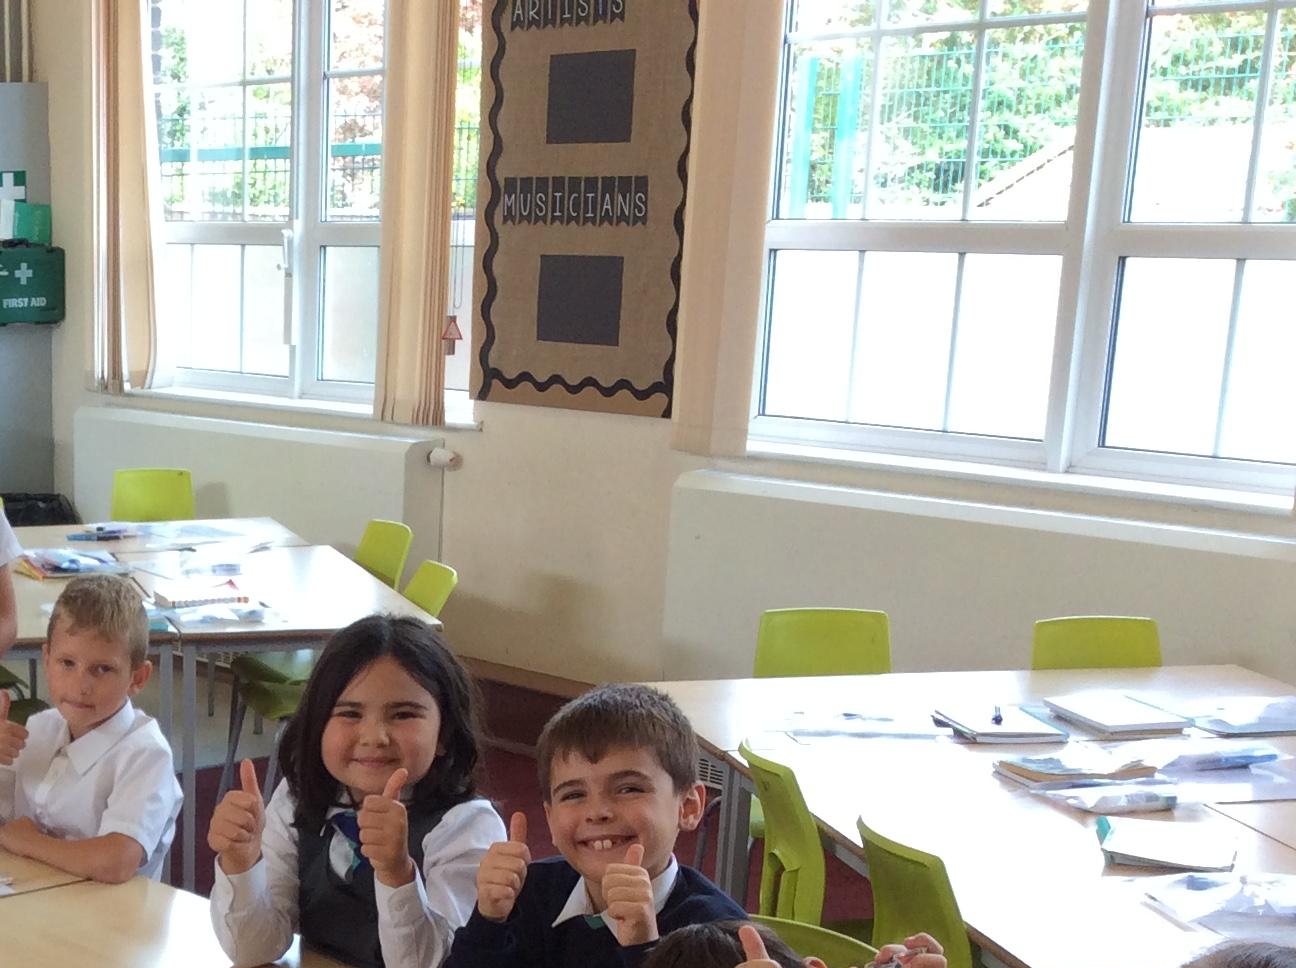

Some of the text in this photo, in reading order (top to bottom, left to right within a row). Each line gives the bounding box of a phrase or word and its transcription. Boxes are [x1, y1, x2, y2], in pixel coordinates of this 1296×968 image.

[513, 0, 623, 21] ARTISTS
[504, 192, 646, 217] MUSICIANS
[2, 296, 47, 309] FIRST AID
